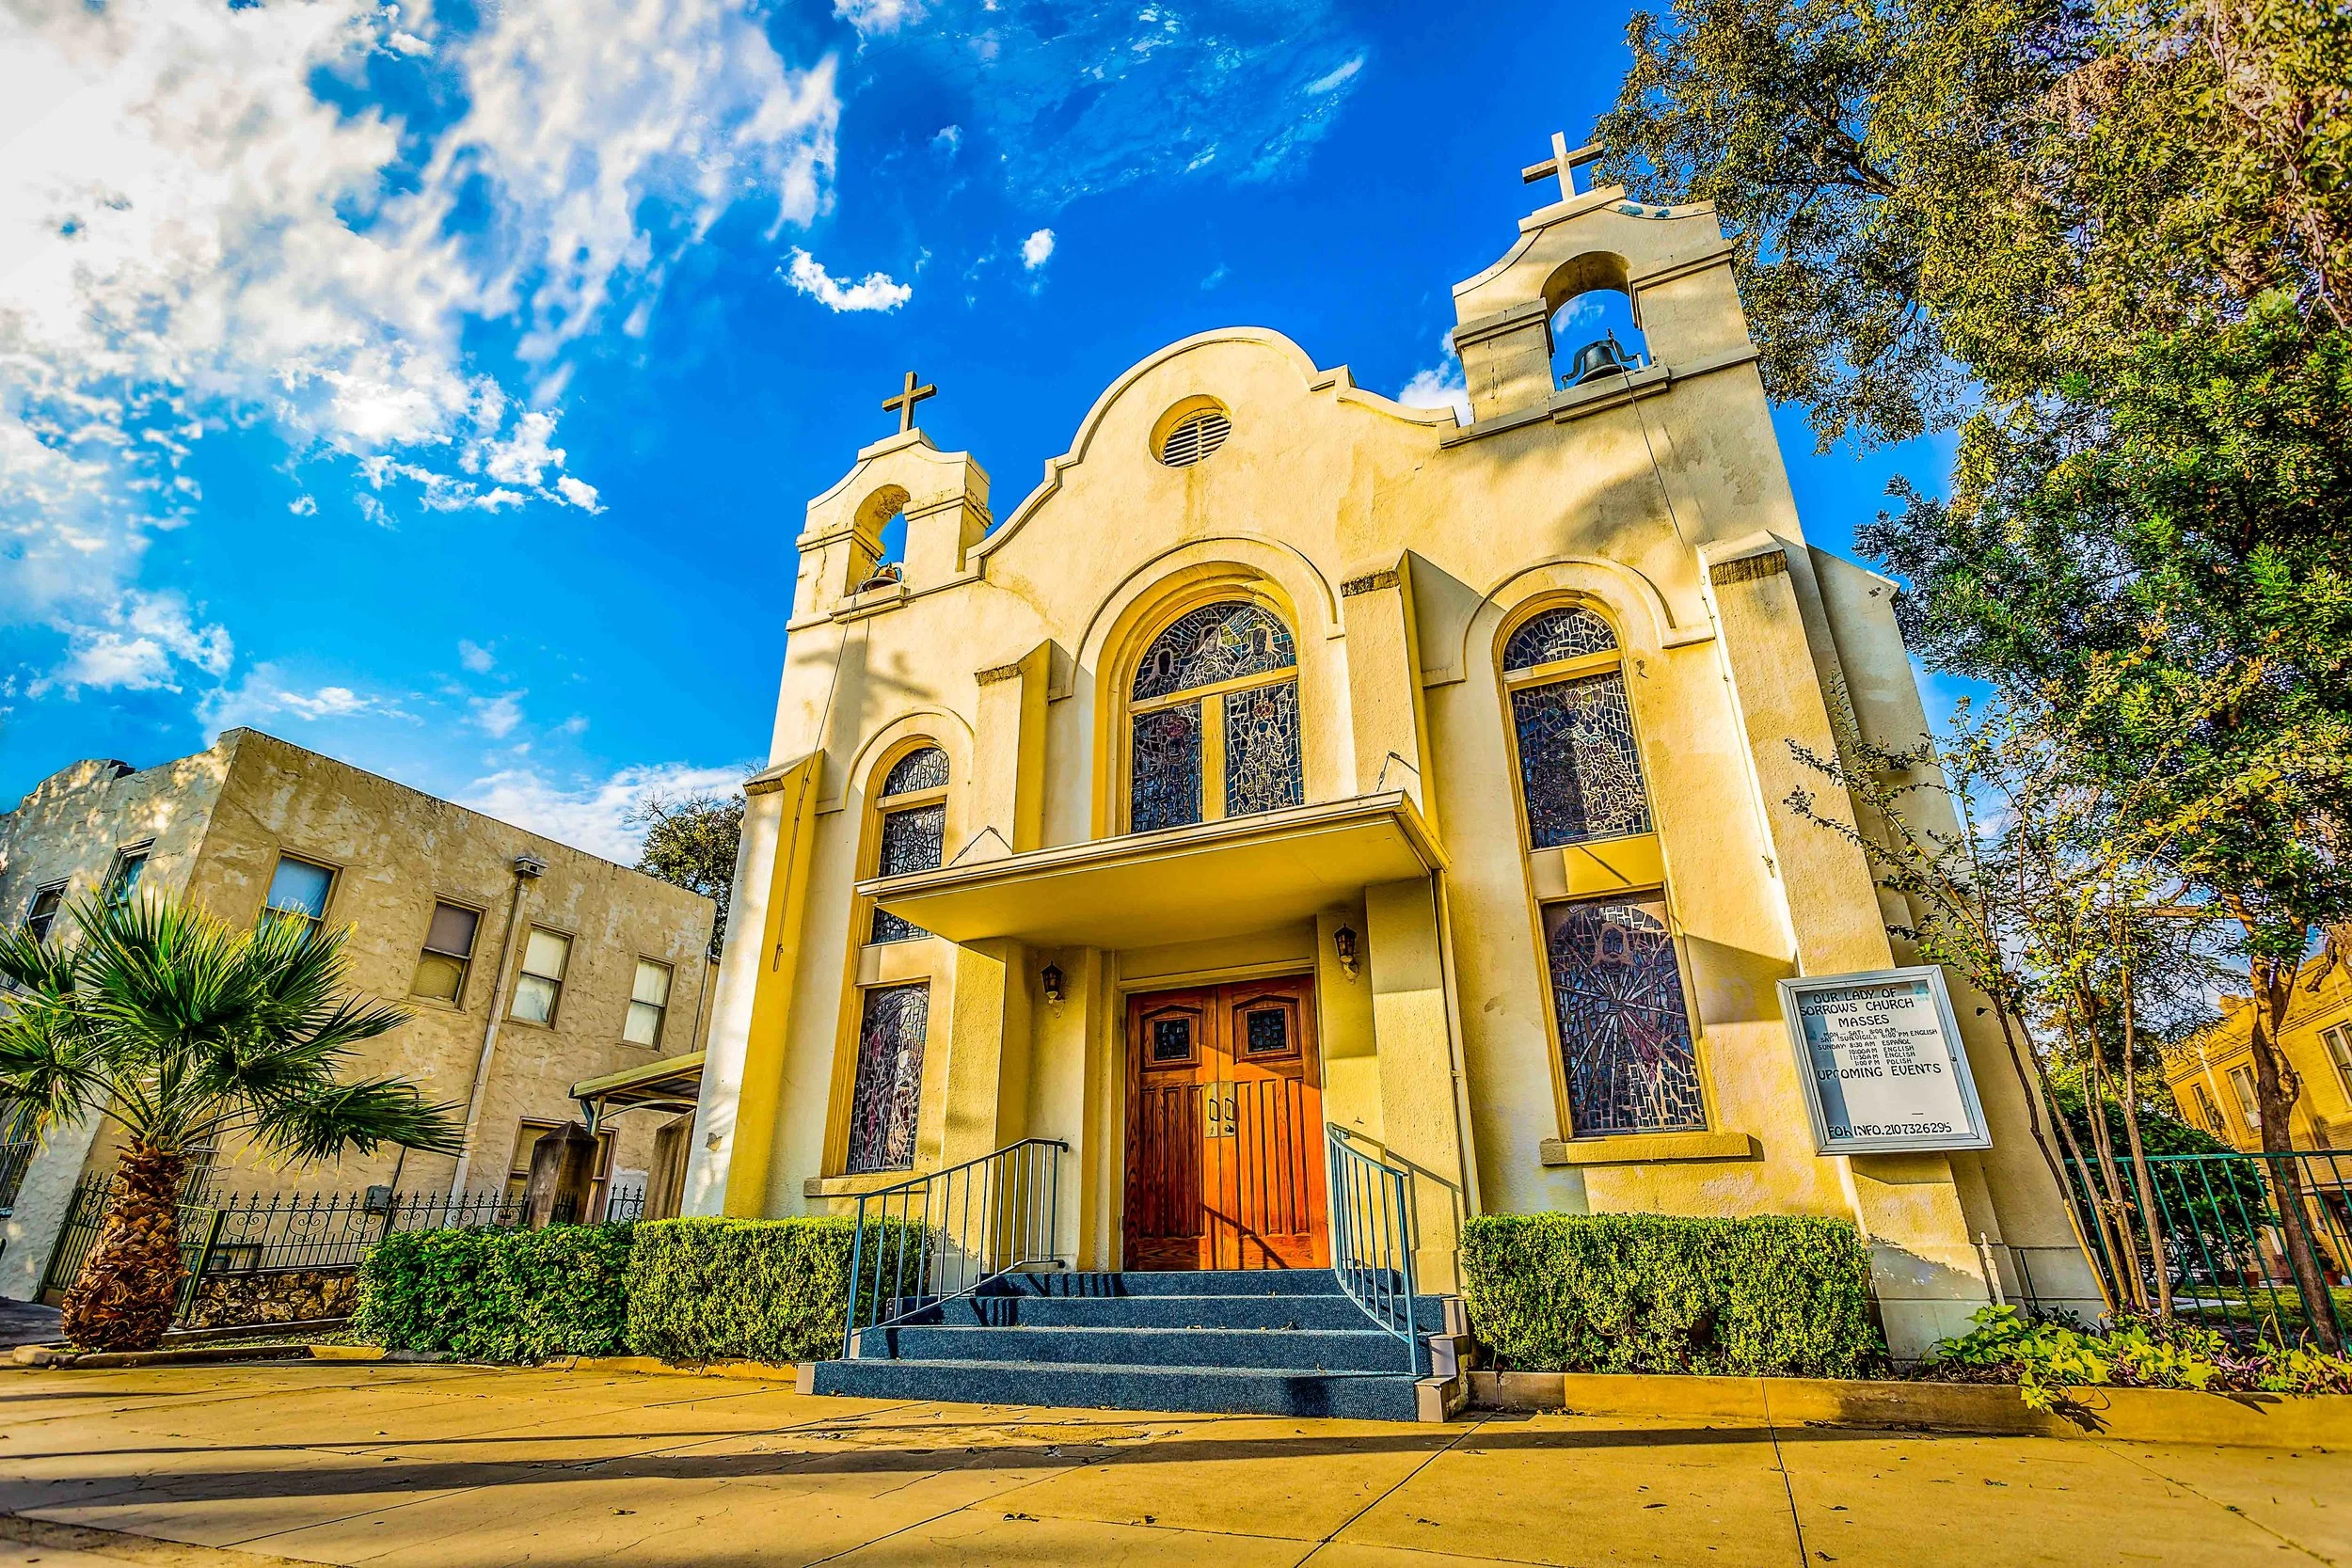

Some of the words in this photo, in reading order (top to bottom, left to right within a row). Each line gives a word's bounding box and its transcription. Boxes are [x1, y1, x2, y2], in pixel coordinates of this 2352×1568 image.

[1813, 992, 1839, 1004] OUR
[1844, 989, 1875, 1002] LADY
[1881, 988, 1897, 998] OF
[1800, 1003, 1858, 1016] SORROWS
[1866, 998, 1915, 1011] CHURCH
[1837, 1014, 1890, 1027] MASSES
[1890, 1063, 1942, 1077] EVENTS
